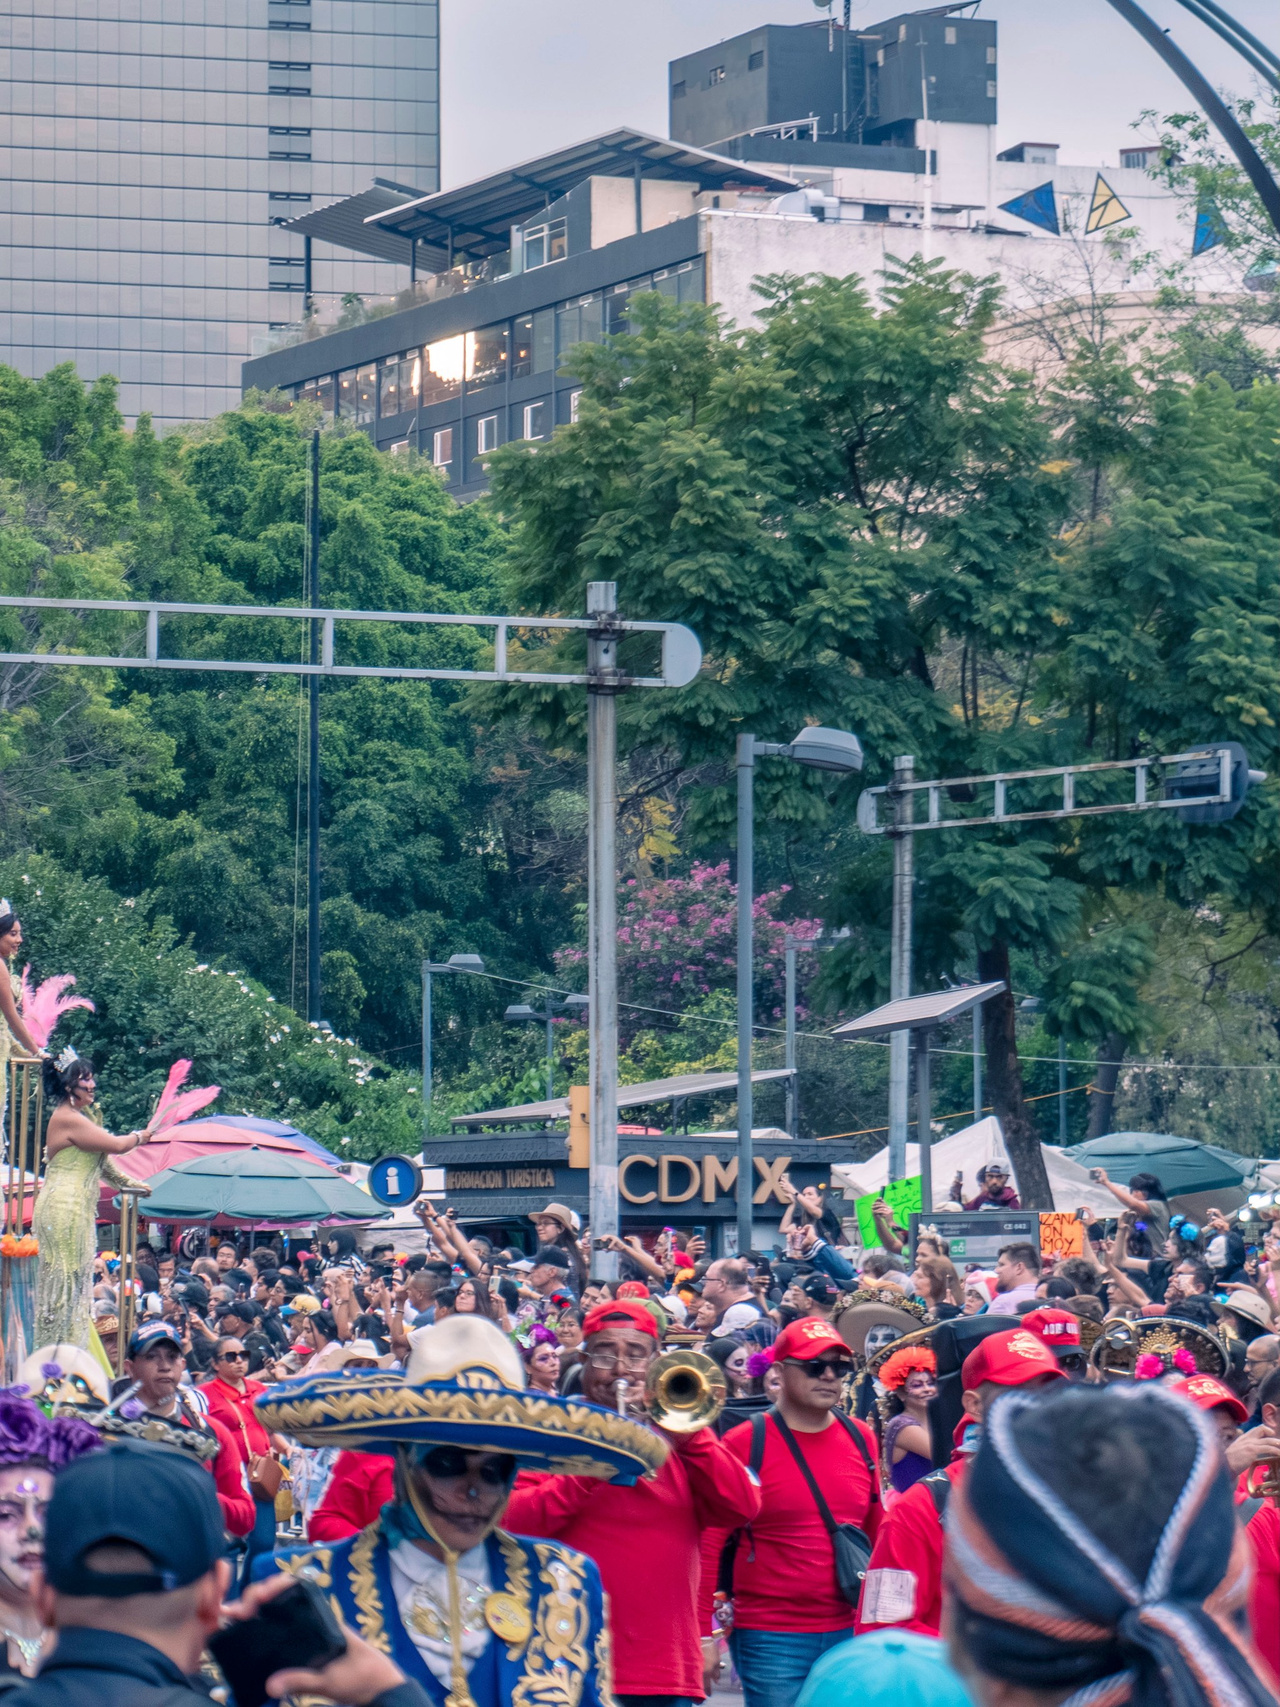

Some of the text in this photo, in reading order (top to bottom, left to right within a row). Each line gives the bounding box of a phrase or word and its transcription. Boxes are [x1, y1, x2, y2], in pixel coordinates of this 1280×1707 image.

[619, 1154, 793, 1204] CDMX
[1042, 1226, 1062, 1238] ON
[1041, 1238, 1075, 1255] MOY
